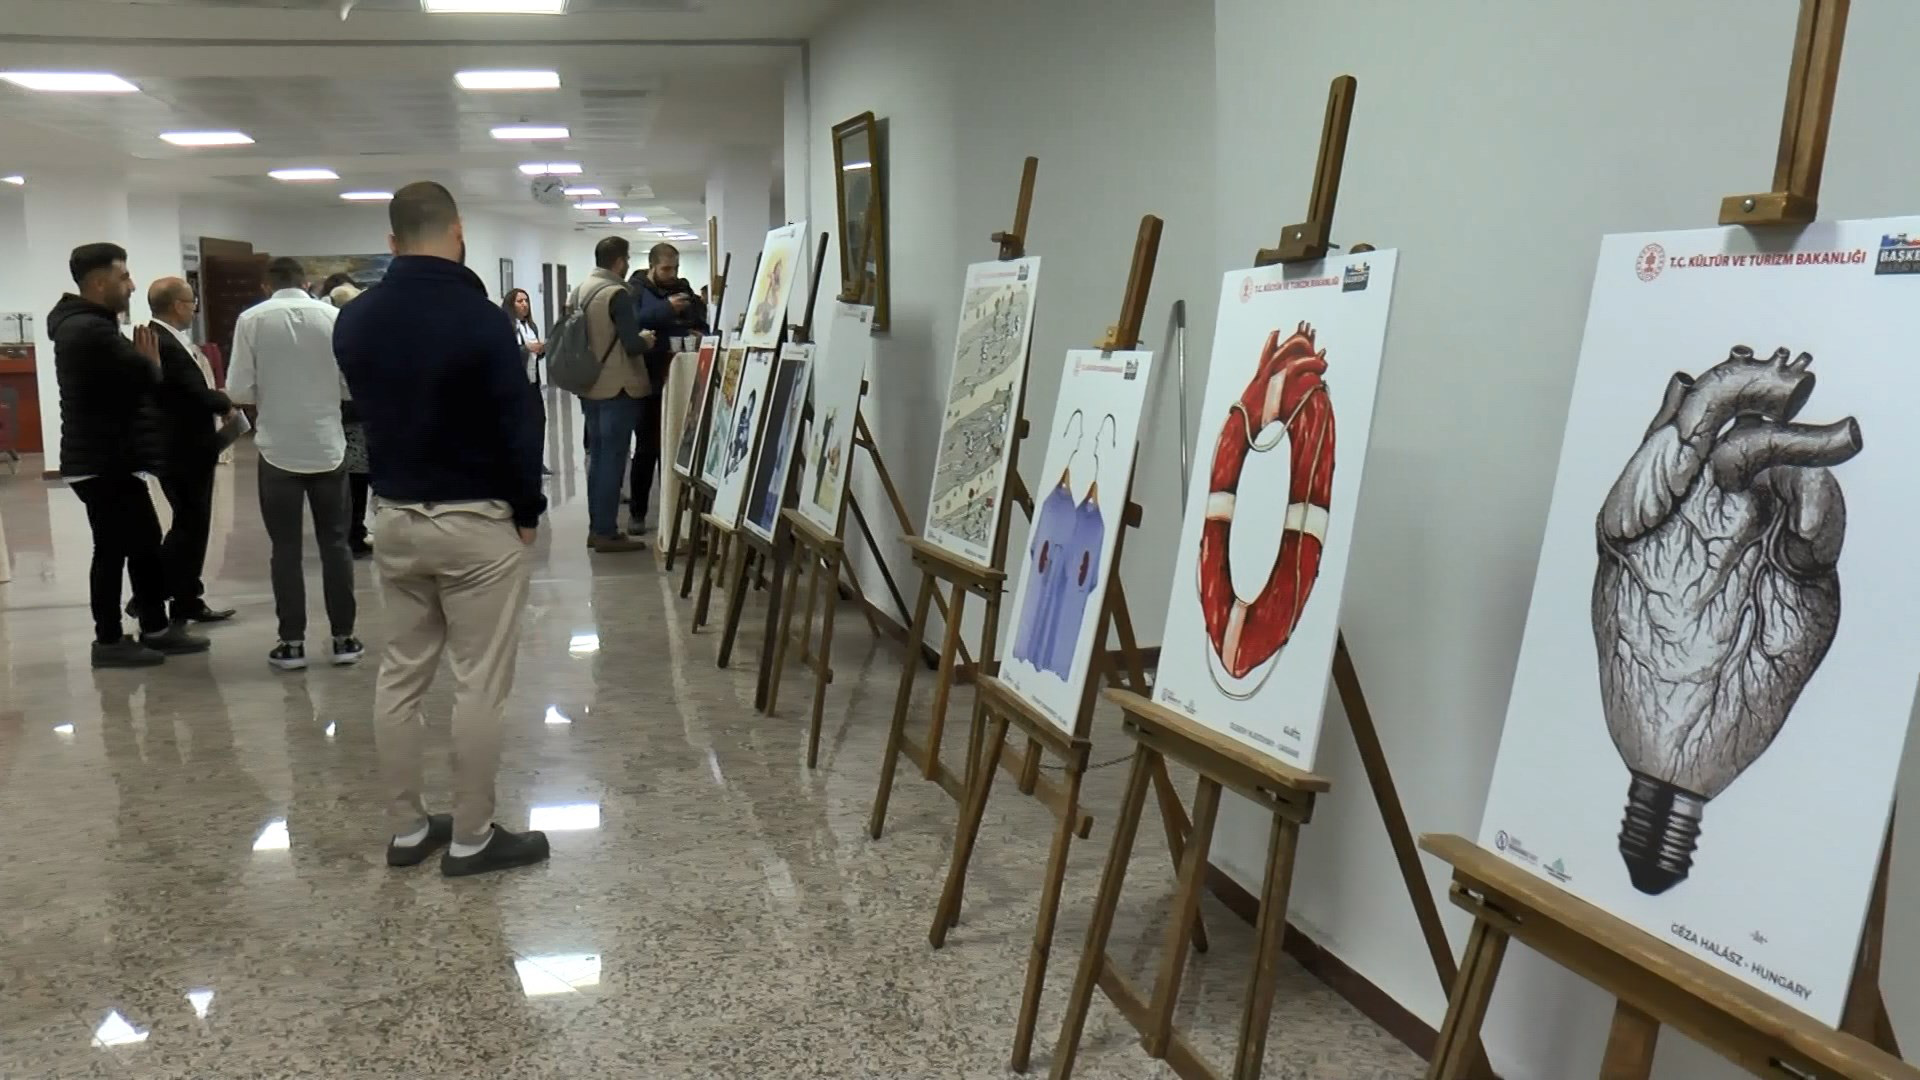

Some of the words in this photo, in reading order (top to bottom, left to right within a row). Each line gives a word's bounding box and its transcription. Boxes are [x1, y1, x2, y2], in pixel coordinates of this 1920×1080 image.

[1688, 253, 1730, 268] KÜLTÜR
[1732, 255, 1746, 267] VE
[1748, 253, 1794, 267] TURİZM
[1795, 249, 1867, 266] BAKANLIĞI
[1751, 962, 1812, 1000] HUNGARY
